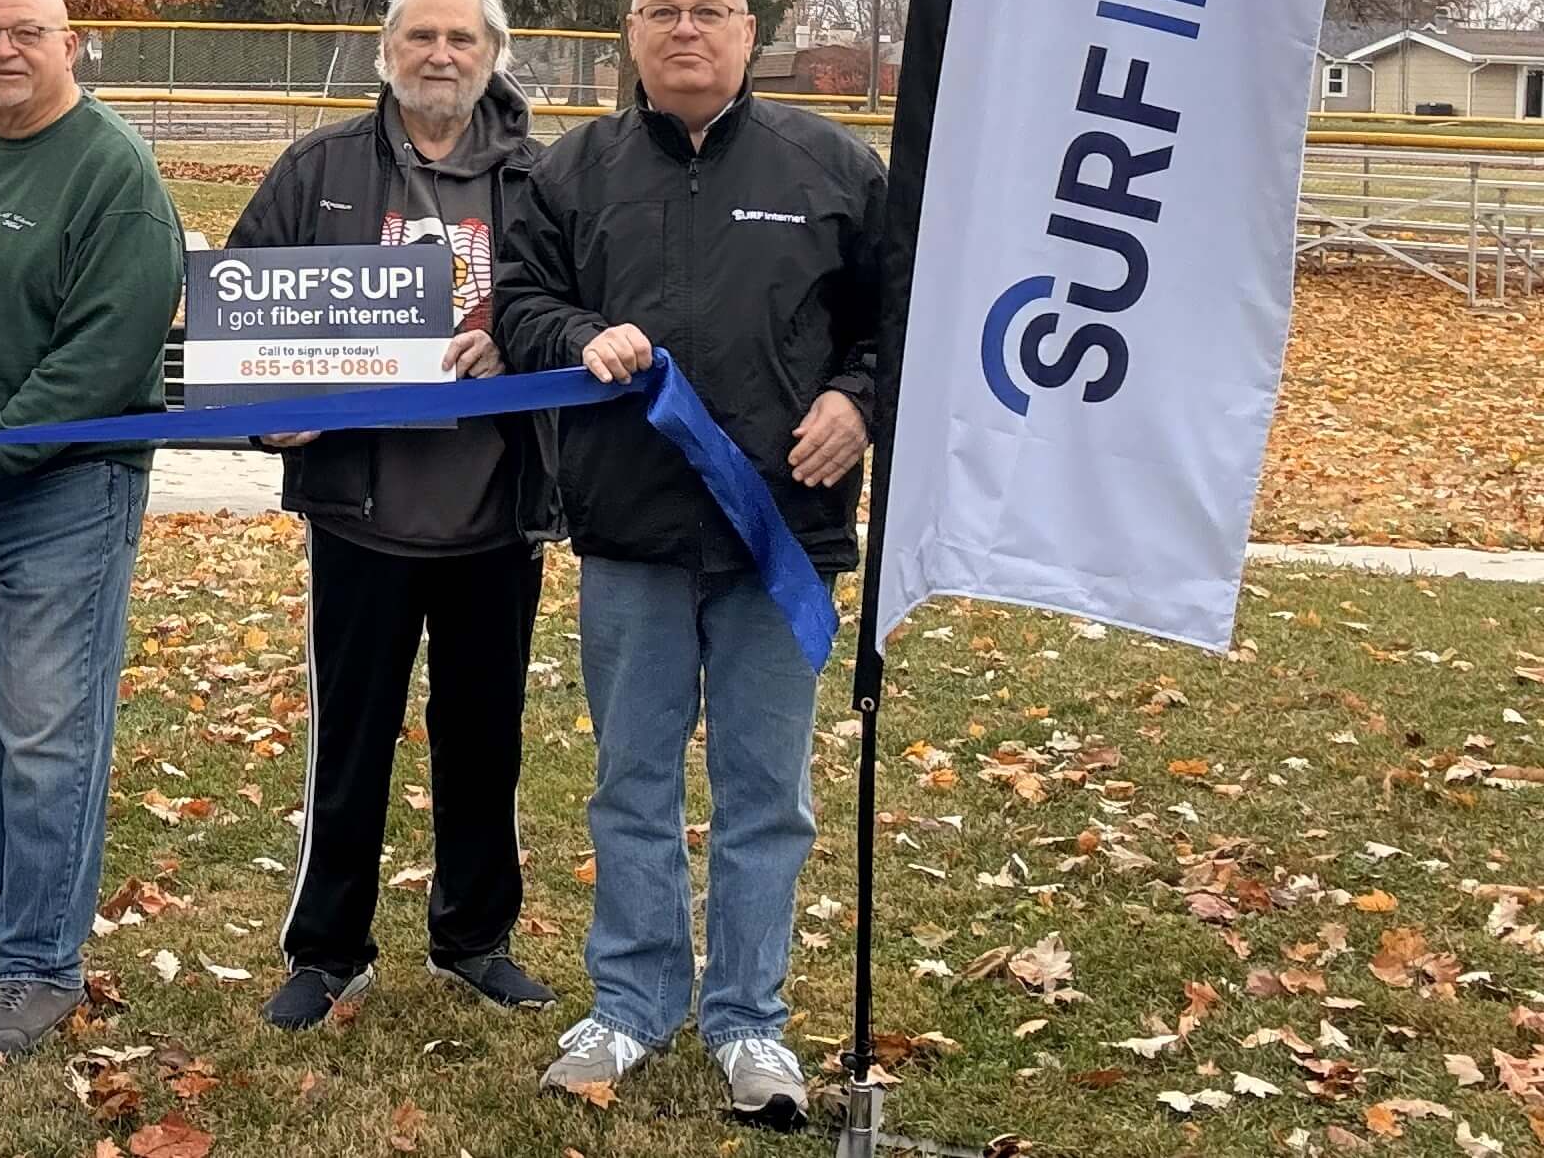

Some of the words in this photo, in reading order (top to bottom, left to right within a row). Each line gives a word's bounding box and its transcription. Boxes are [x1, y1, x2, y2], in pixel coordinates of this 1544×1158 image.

[1019, 44, 1181, 404] SURF
[216, 267, 354, 303] SURF'S
[361, 266, 425, 299] UP!
[217, 307, 222, 326] I
[229, 307, 265, 331] got
[271, 305, 323, 325] fiber
[328, 304, 426, 325] internet.
[258, 345, 281, 357] Call
[283, 346, 295, 356] to
[297, 346, 323, 358] sign
[325, 346, 340, 357] up
[342, 345, 379, 357] today!
[239, 358, 399, 377] 855-613-0806
